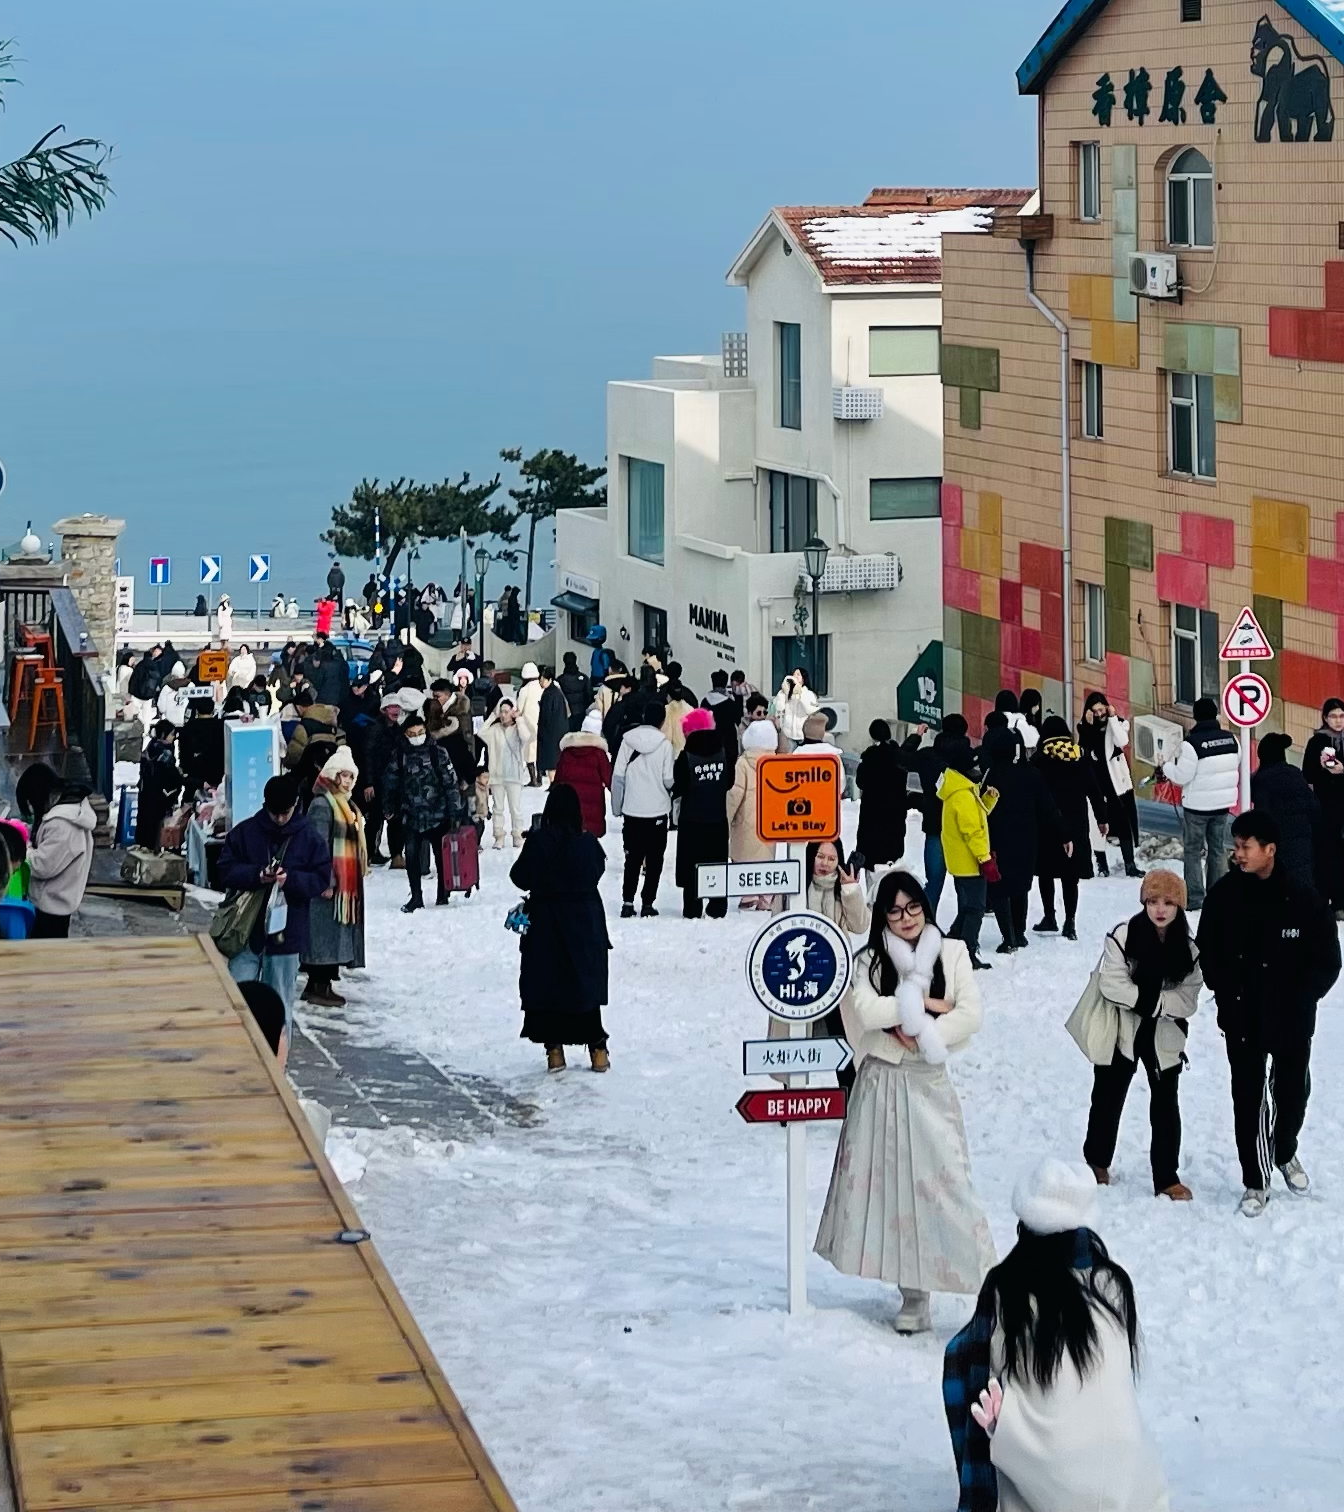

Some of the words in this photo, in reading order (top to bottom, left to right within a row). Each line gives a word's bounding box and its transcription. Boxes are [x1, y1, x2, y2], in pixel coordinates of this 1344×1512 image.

[689, 603, 729, 637] MANNA
[785, 766, 832, 784] smile
[739, 872, 762, 887] SEE
[765, 870, 789, 886] SEA
[762, 1047, 822, 1066] 火炬八街
[767, 1099, 785, 1116] BE
[788, 1097, 832, 1115] HAPPY
